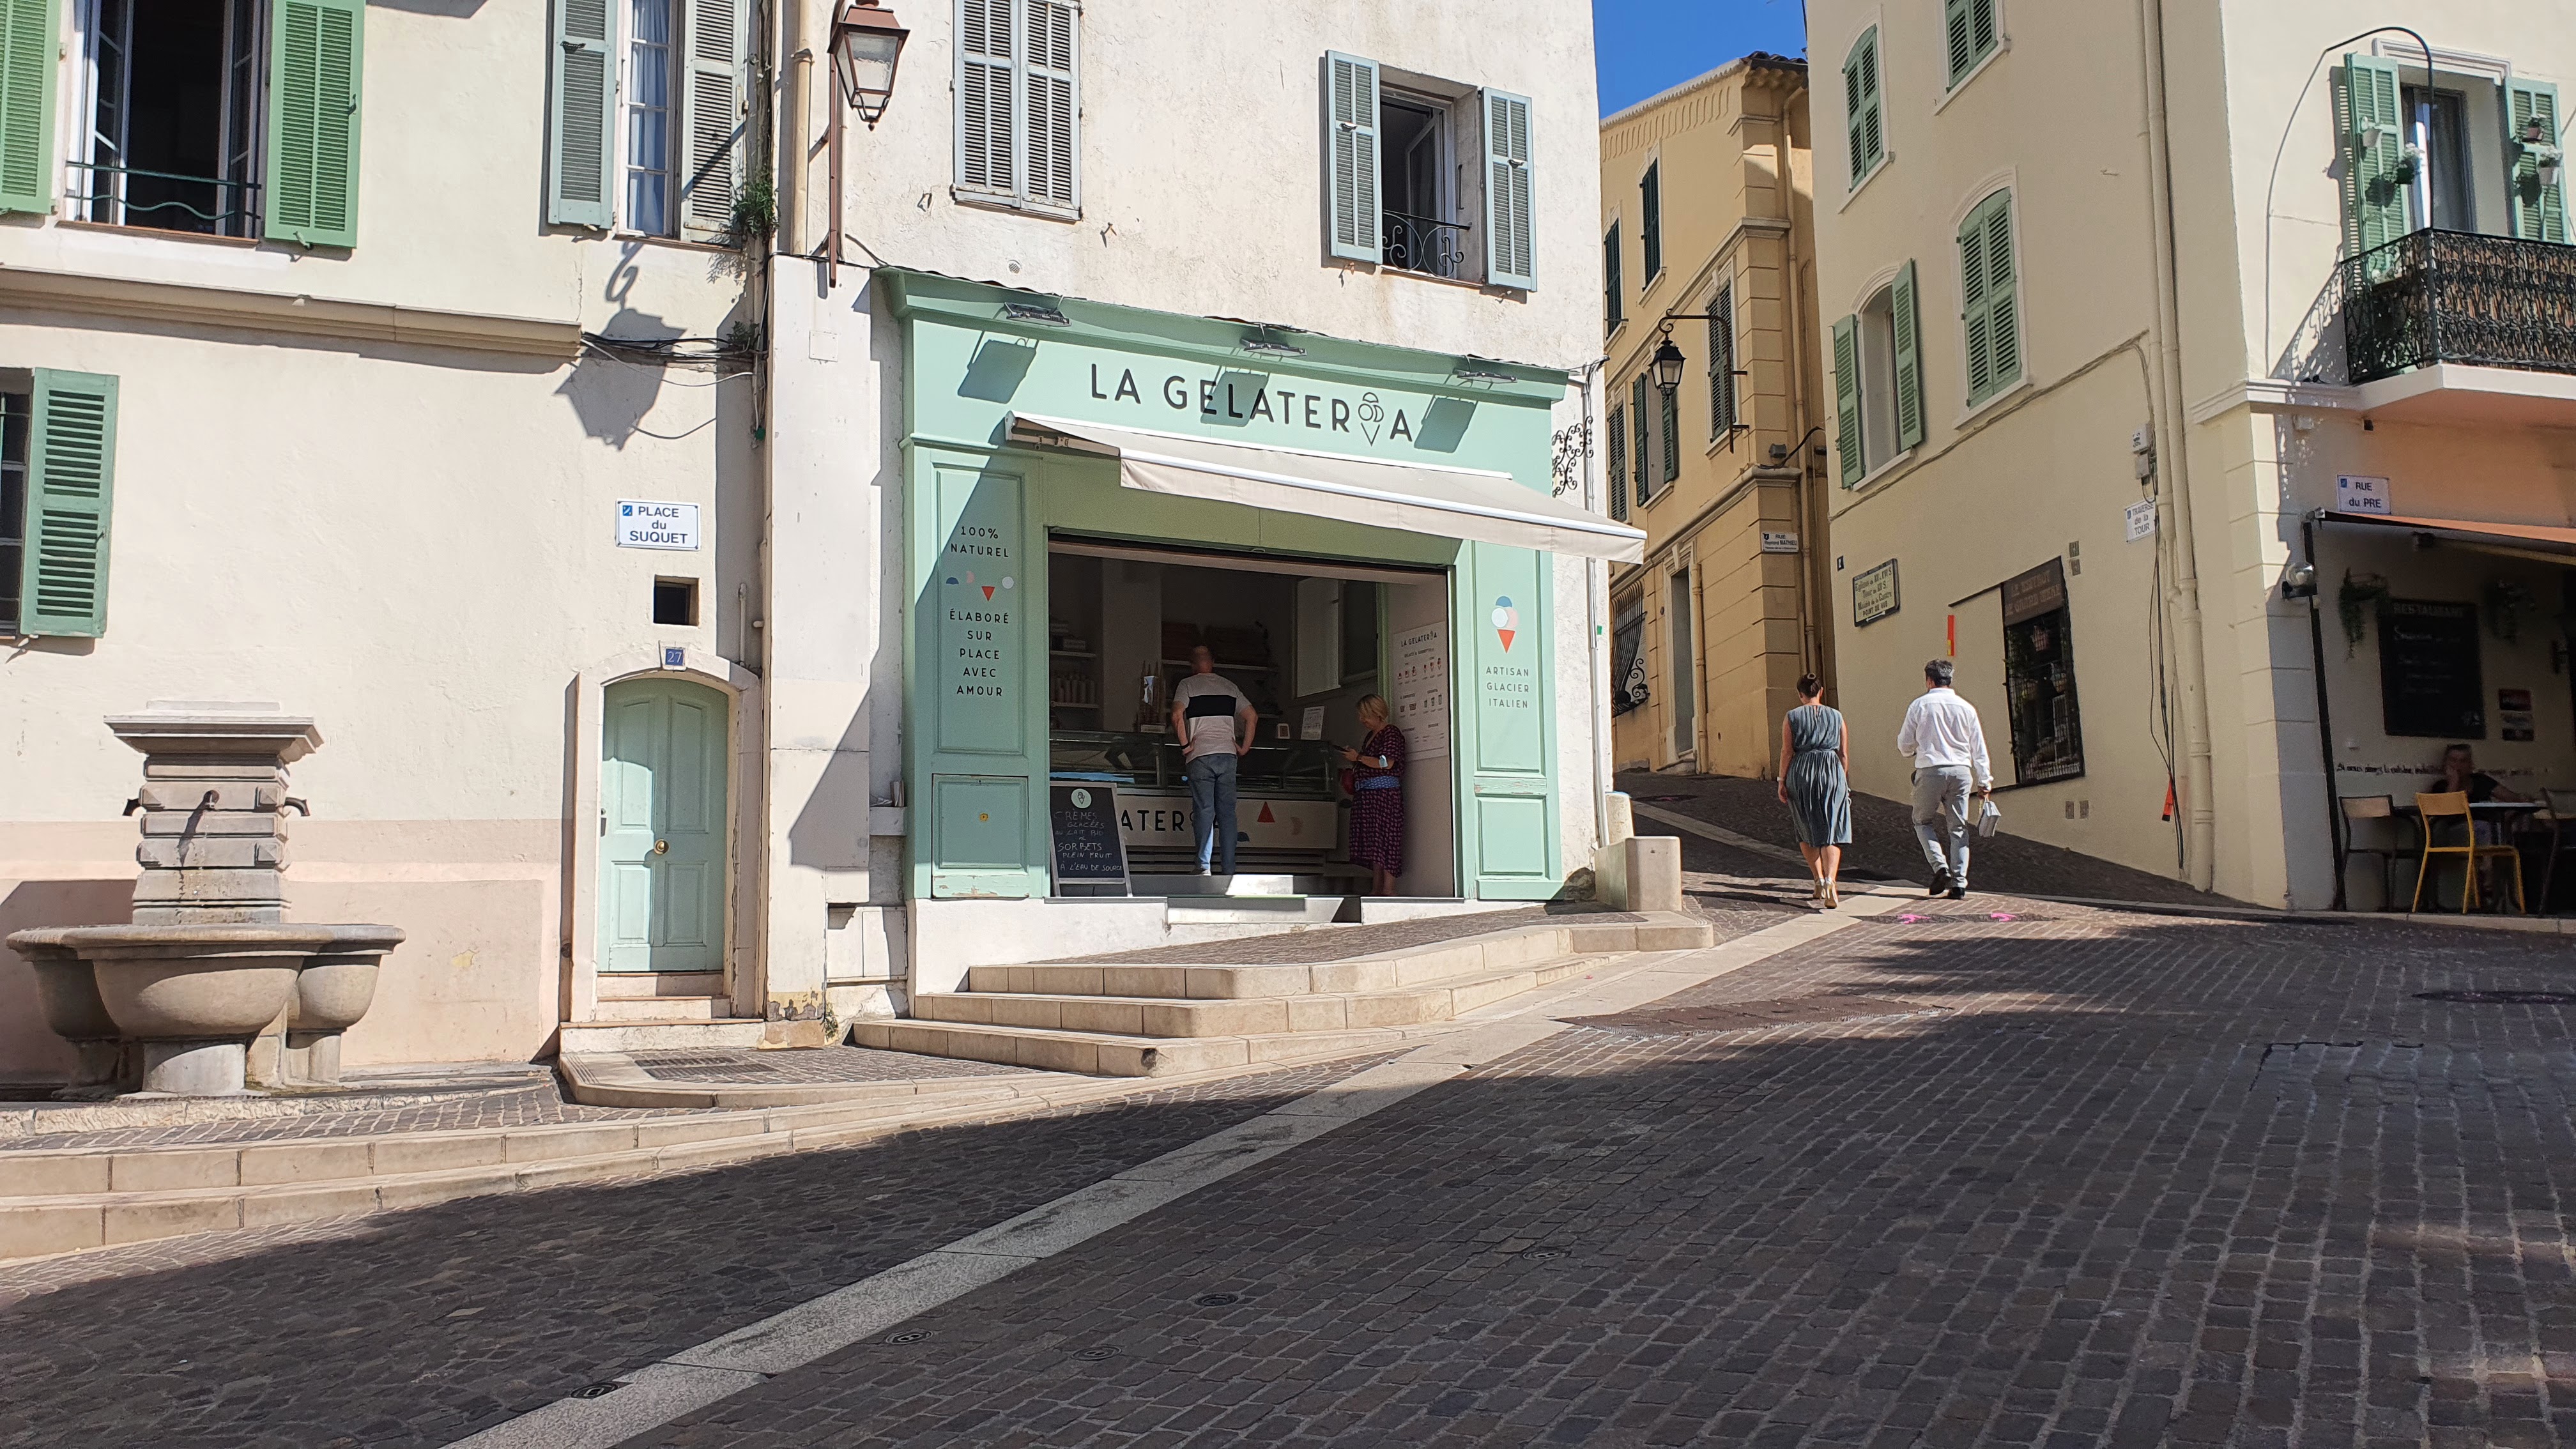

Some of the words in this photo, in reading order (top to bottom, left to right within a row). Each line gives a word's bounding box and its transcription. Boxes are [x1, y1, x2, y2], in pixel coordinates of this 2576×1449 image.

[1091, 363, 1141, 404] LA
[2355, 481, 2373, 491] RUE
[2349, 497, 2360, 507] du
[638, 505, 680, 518] PLACE
[651, 519, 666, 530] du
[2134, 522, 2150, 535] TOUR
[629, 530, 688, 544] SUQUET
[960, 526, 999, 539] 100%
[951, 542, 1009, 558] NATUREL
[949, 608, 1009, 624] ÉLABORÉ
[967, 630, 992, 641] SUR
[667, 651, 682, 663] 27
[960, 648, 1000, 660] PLACE
[963, 666, 997, 678] AVEC
[1485, 666, 1529, 677] ARTISAN
[956, 684, 1002, 696] AMOUR
[1486, 682, 1529, 693] GLACIER
[1489, 698, 1528, 709] ITALIEN
[1067, 820, 1105, 829] GLACÉES
[1057, 842, 1102, 852] SORBETS
[1070, 862, 1088, 871] L'EAU
